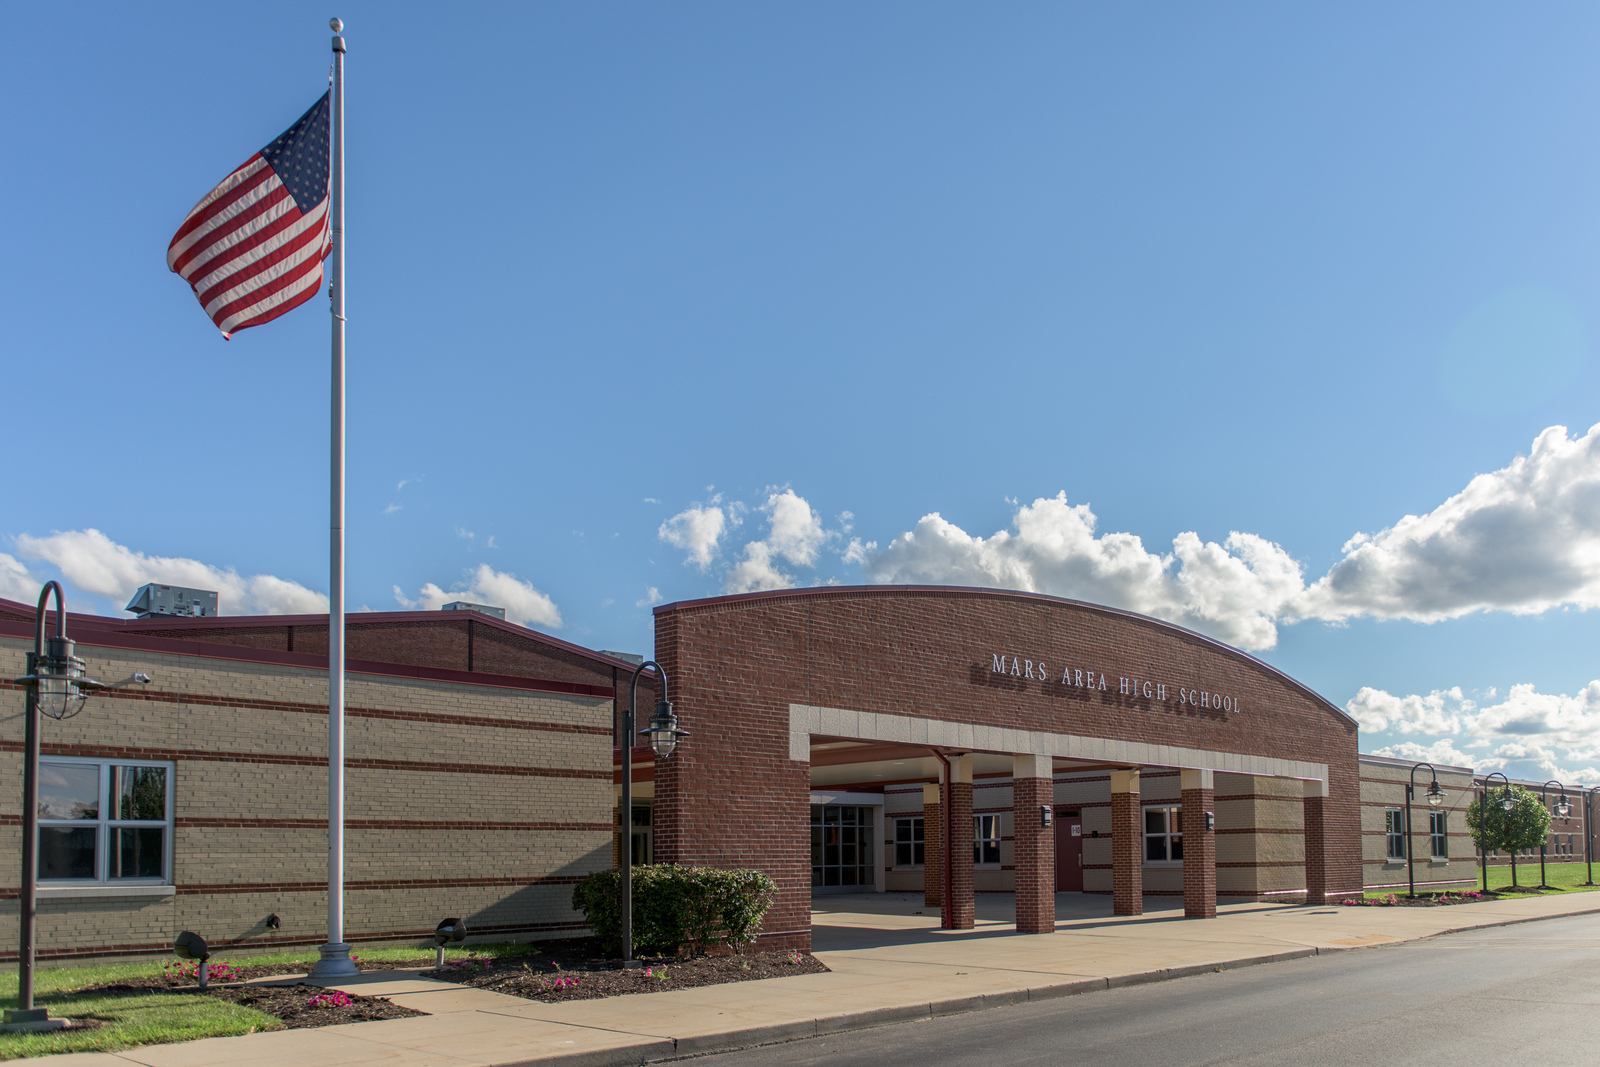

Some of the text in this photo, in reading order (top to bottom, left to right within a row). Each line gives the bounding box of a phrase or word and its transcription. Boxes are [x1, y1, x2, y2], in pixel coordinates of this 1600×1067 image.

[992, 653, 1240, 713] MARS AREA HIGH SCHOOL
